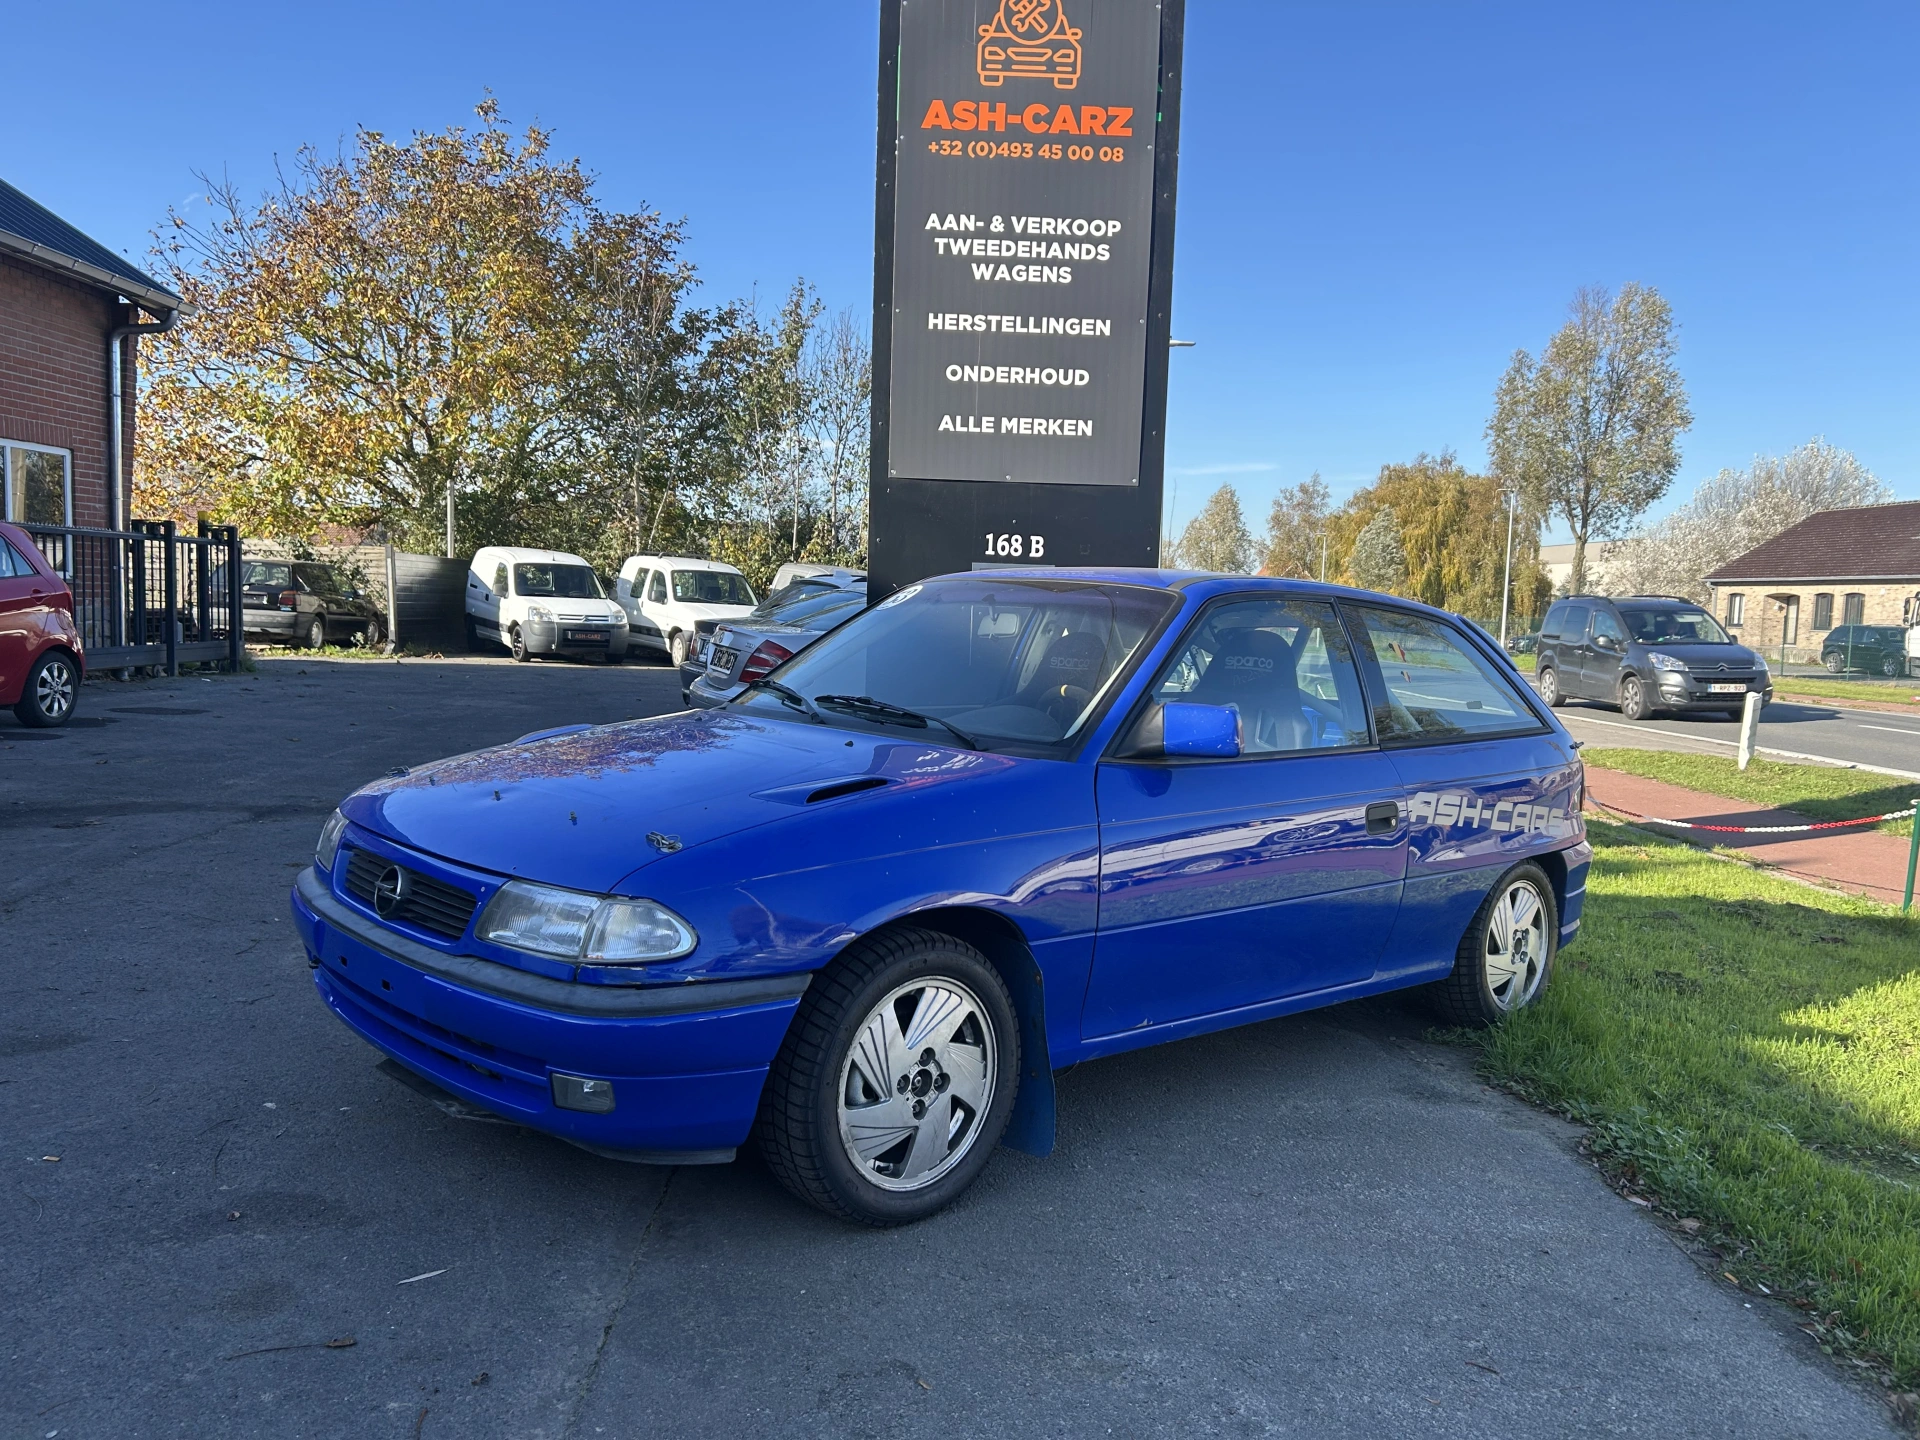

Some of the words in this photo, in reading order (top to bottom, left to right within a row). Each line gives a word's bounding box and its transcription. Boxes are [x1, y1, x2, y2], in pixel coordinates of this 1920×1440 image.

[921, 99, 1133, 137] ASH-CARZ
[928, 140, 962, 156] +32
[967, 141, 1033, 159] (0)493
[1038, 144, 1062, 160] 45
[1067, 145, 1094, 161] 00
[1099, 146, 1124, 162] 08
[925, 213, 984, 231] AAN-
[989, 215, 1005, 233] &
[1011, 216, 1122, 237] VERKOOP
[934, 237, 1111, 261] TWEEDEHANDS
[971, 263, 1072, 284] WAGENS
[928, 313, 1111, 336] HERSTELLINGEN
[945, 364, 1090, 386] ONDERHOUD
[938, 414, 995, 433] ALLE
[1001, 417, 1093, 437] MERKEN
[985, 532, 1023, 557] 168
[1029, 535, 1045, 558] B
[1050, 656, 1090, 669] sparco
[1225, 655, 1274, 670] sparco
[1410, 791, 1565, 836] ASH-CARS
